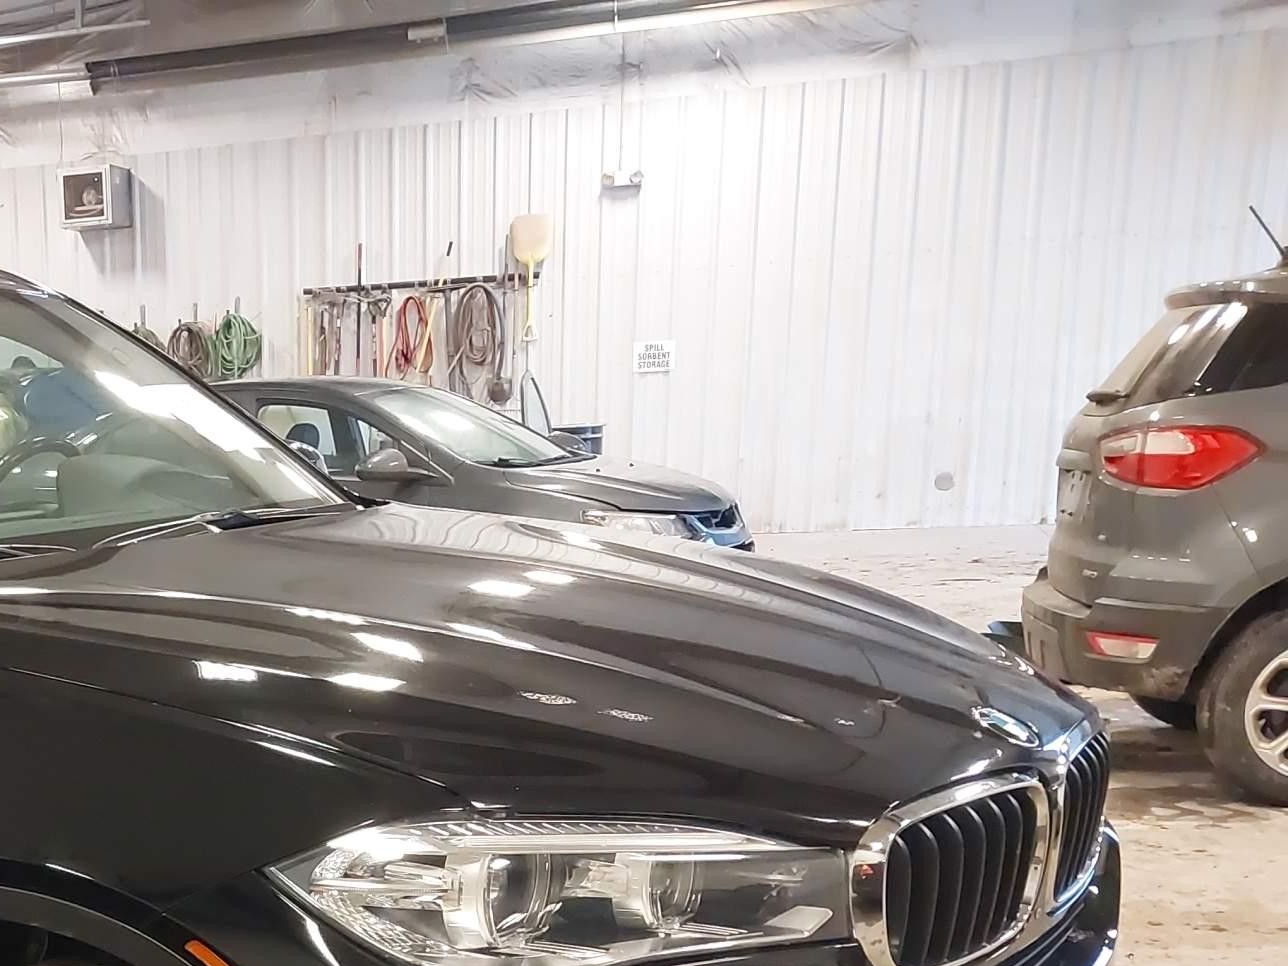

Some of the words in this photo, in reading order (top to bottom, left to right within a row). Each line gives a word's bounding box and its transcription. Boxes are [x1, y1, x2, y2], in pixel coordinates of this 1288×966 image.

[644, 344, 664, 352] SPILL
[638, 352, 670, 361] SORBENT
[638, 360, 670, 369] STORAGE
